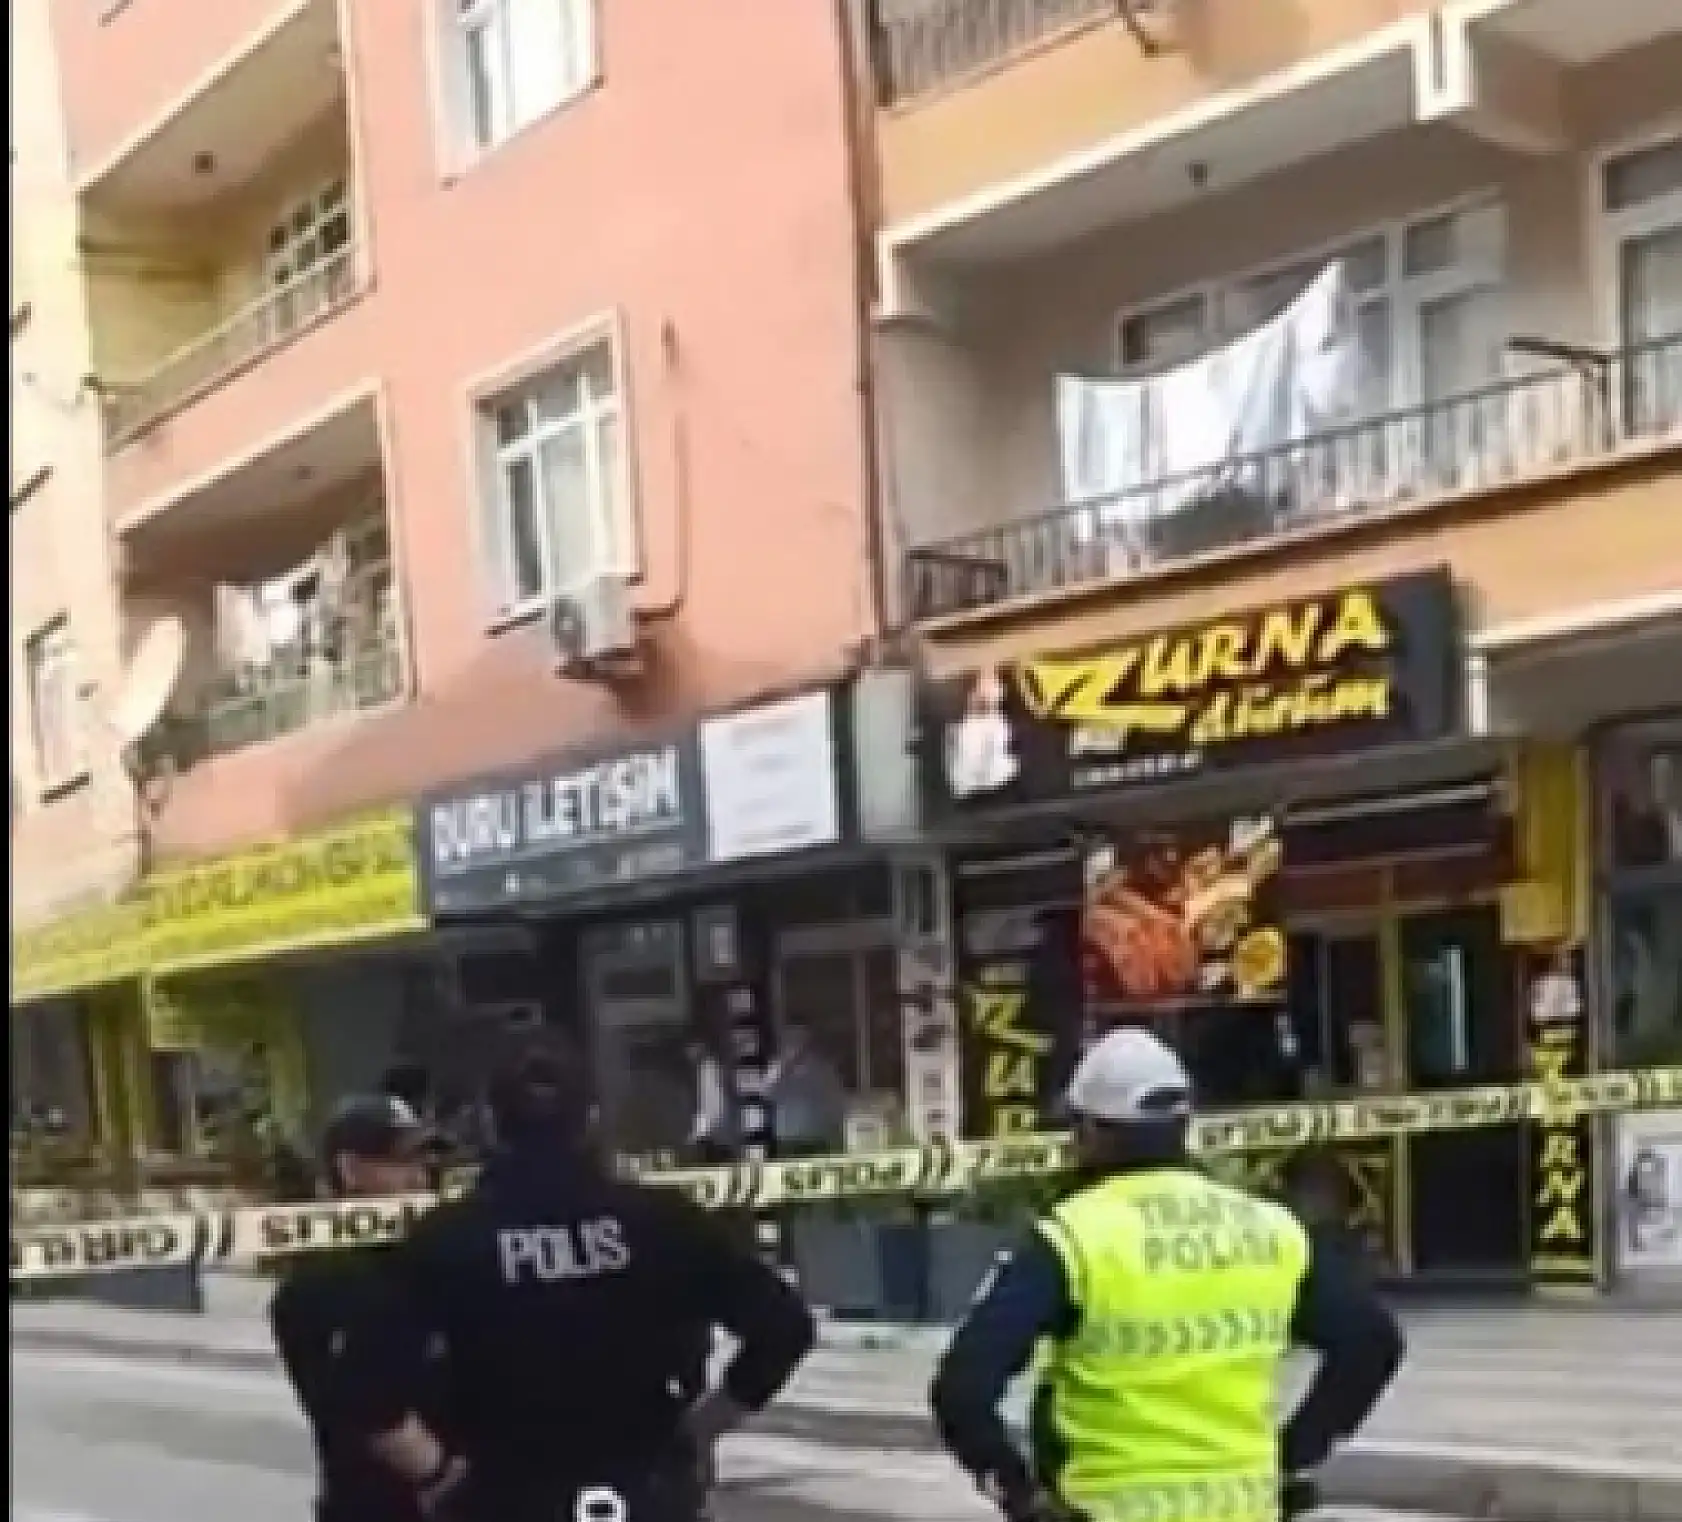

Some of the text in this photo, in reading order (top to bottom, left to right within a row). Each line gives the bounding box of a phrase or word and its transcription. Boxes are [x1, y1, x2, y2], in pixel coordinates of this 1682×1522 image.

[1024, 590, 1391, 730] ZURNA
[432, 792, 517, 862] DURU
[1531, 1046, 1584, 1240] ZRNA
